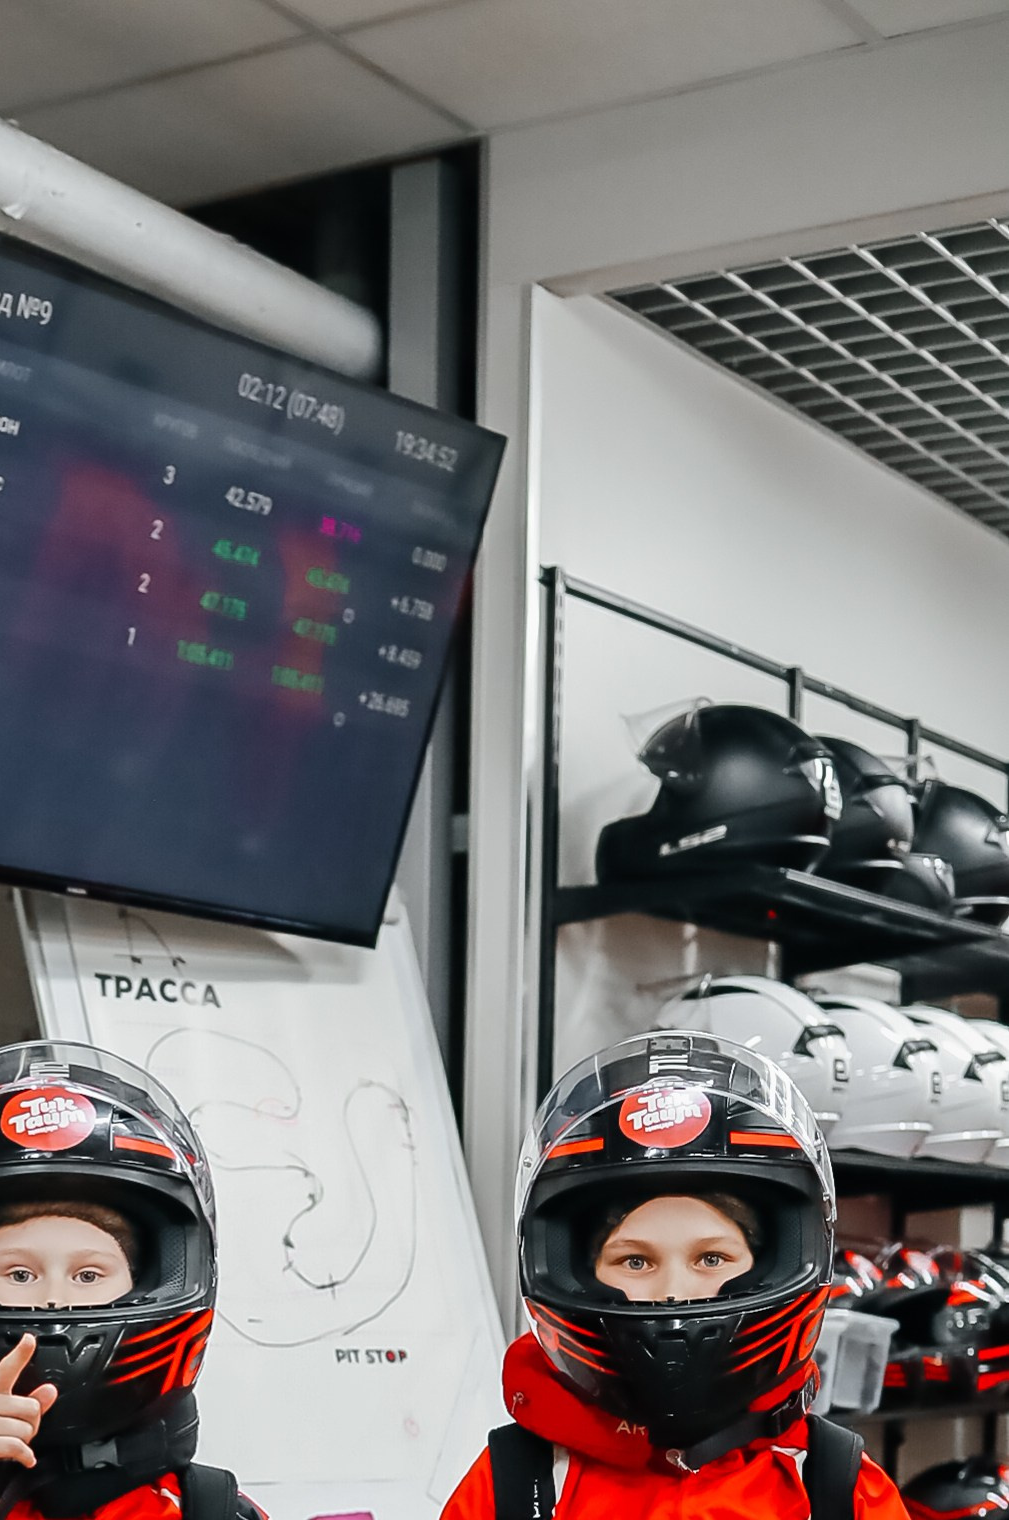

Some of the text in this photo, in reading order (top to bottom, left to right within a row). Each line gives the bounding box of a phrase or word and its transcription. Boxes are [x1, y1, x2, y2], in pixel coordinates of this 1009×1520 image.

[16, 293, 53, 325] №9
[237, 373, 287, 411] 02:12
[162, 465, 176, 485] 3
[150, 519, 165, 541] 2
[138, 573, 151, 594] 2
[127, 626, 136, 647] 1
[94, 972, 222, 1009] ТРАССА
[335, 1349, 408, 1364] PIT STOP
